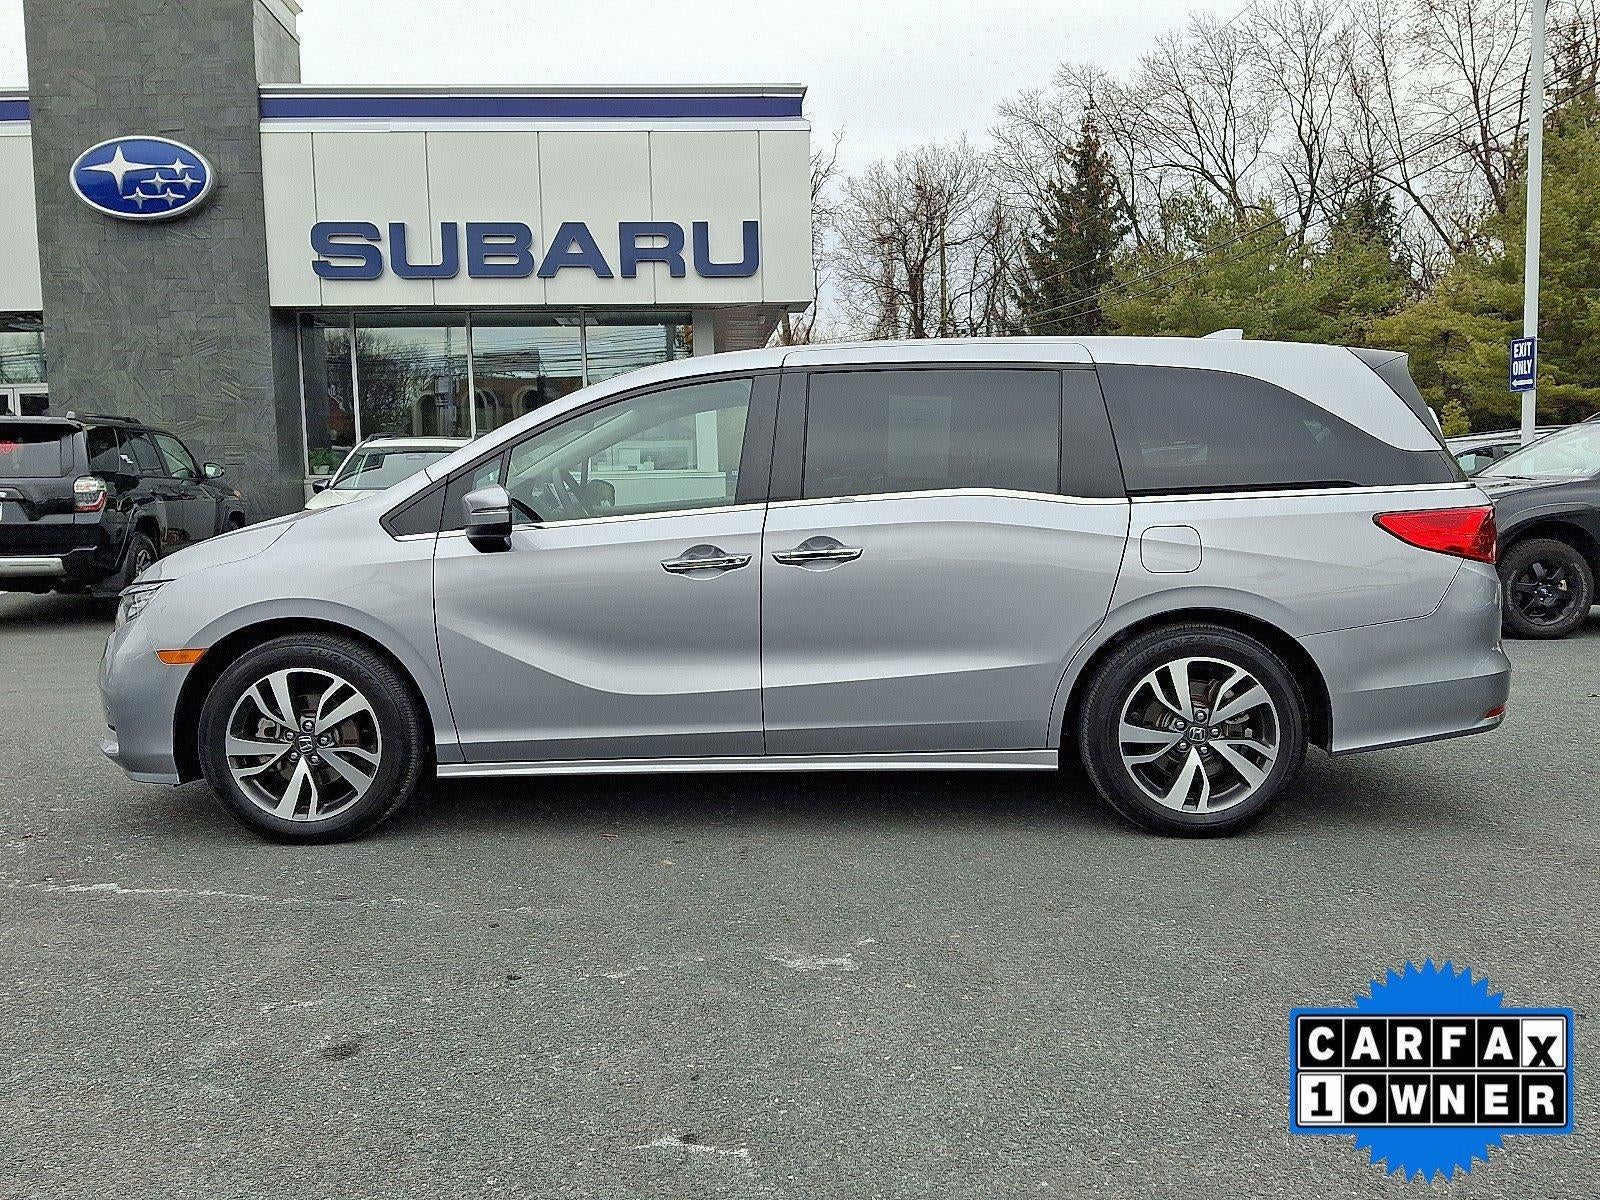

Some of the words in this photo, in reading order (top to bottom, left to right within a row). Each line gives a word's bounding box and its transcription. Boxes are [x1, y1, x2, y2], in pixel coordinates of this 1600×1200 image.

[311, 221, 760, 279] SUBARU
[1514, 342, 1532, 358] EXIT
[1513, 359, 1532, 375] ONLY
